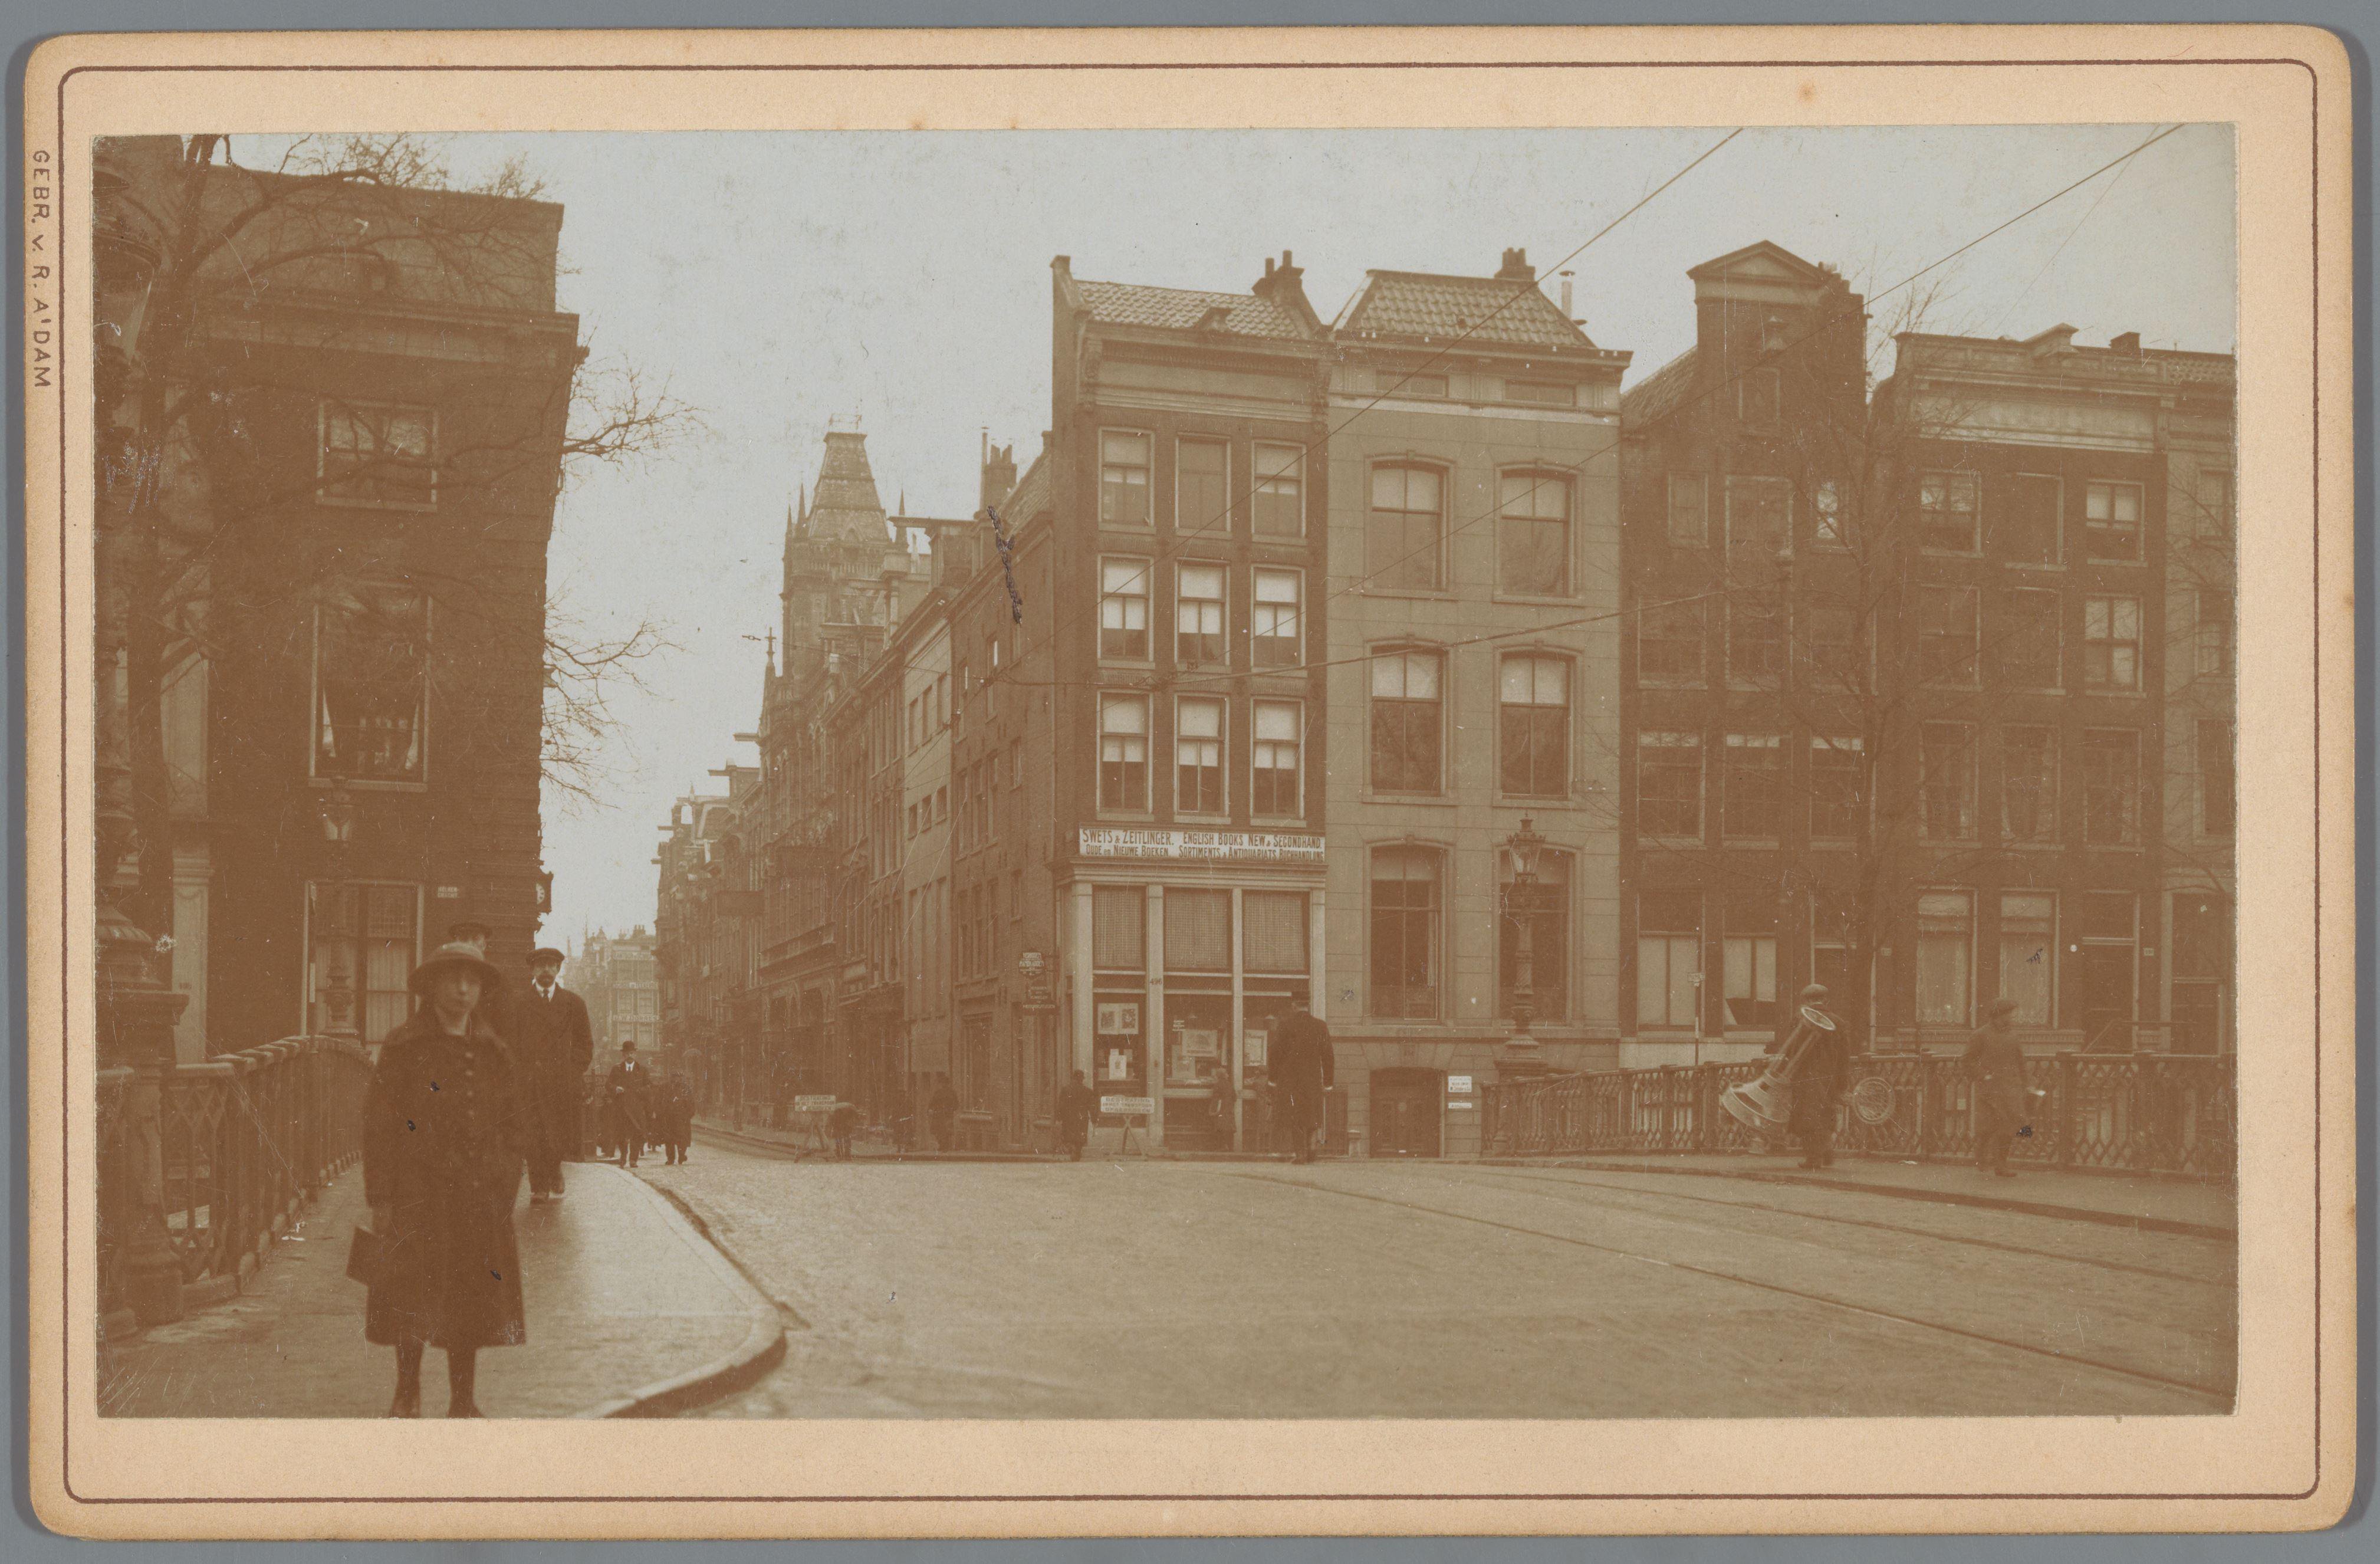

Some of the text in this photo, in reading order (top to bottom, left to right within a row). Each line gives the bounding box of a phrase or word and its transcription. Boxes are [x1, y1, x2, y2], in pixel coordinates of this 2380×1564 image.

[31, 150, 51, 224] GEBR.
[32, 265, 51, 288] R.
[33, 298, 51, 387] A'DAM
[1083, 829, 1174, 845] SWETS & ZEITLINGER.
[1183, 832, 1214, 845] ENGLISH
[1218, 833, 1243, 846] BOOKS
[1248, 834, 1265, 846] NEW
[1273, 834, 1322, 849] SECONDHAND.
[1086, 844, 1102, 855] OUDE
[1113, 845, 1139, 856] NIEUWE
[1142, 845, 1169, 857] BOEKEN
[1179, 845, 1220, 859] SORTIMENTS
[1228, 847, 1277, 860] ANTIQUARIATS
[1279, 849, 1324, 862] BUCHHANDLUNG
